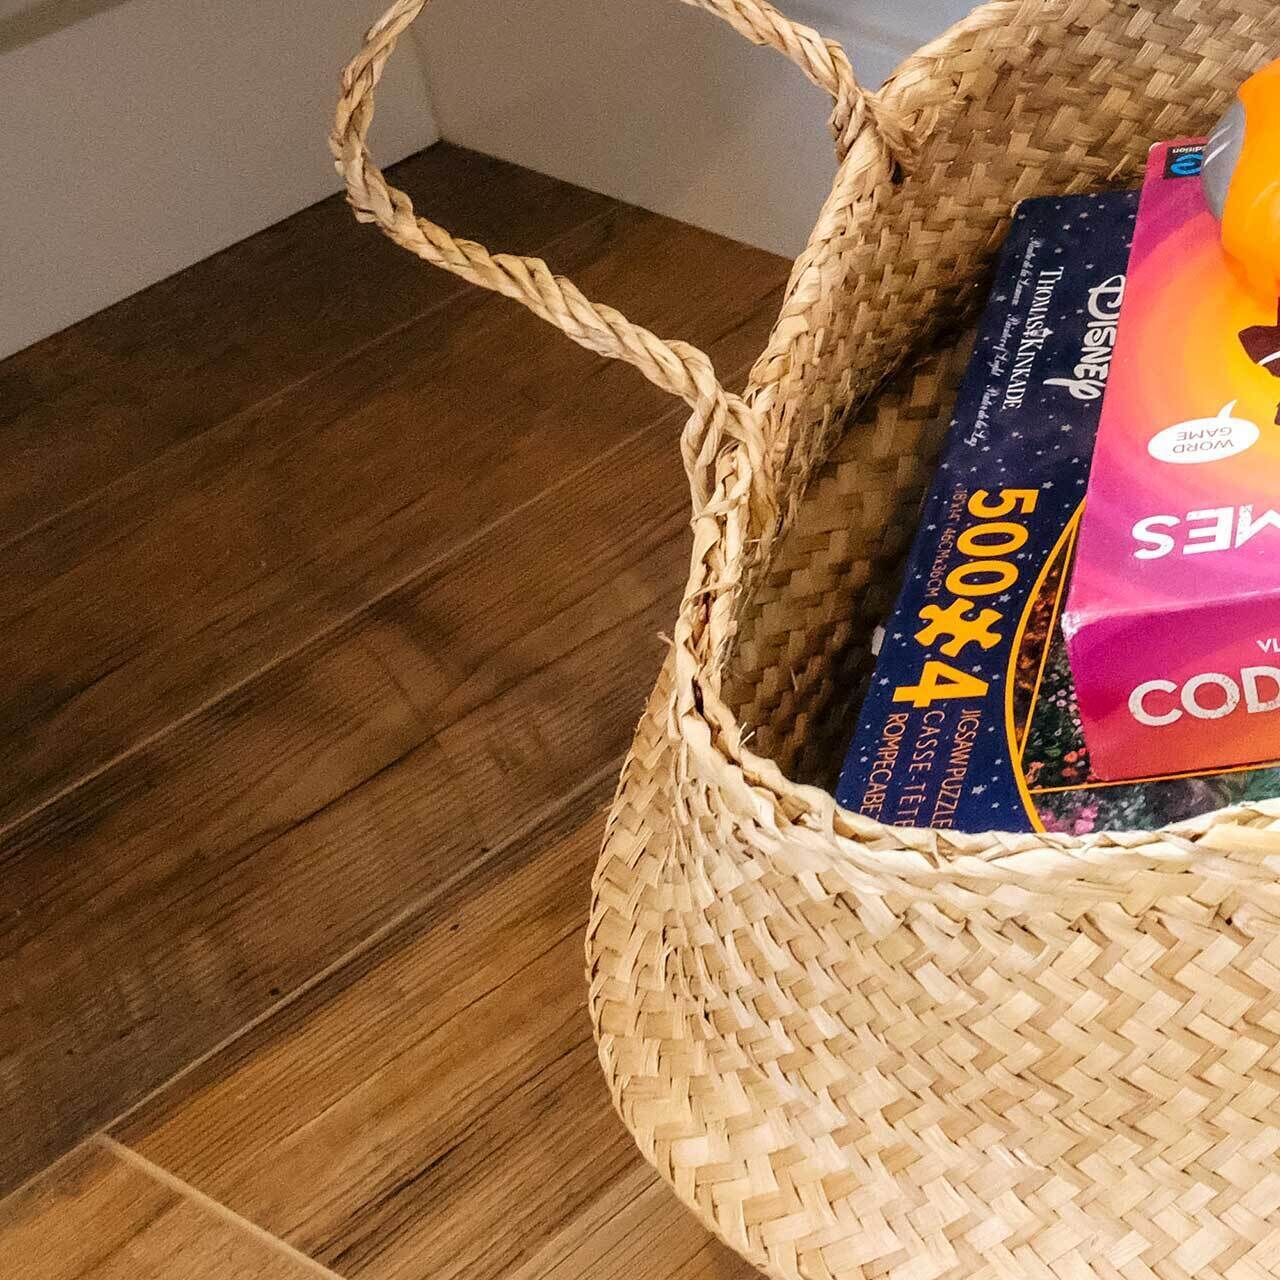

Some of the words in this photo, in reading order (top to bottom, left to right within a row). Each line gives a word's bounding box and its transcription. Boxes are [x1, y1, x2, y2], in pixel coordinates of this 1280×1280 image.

[1002, 336, 1045, 410] KINKADE
[1172, 439, 1235, 454] WORD
[1176, 426, 1233, 441] GAME
[944, 488, 1040, 597] 500
[892, 660, 990, 708] 4
[949, 708, 982, 766] JIGSAW
[859, 712, 910, 821] ROMPECABE
